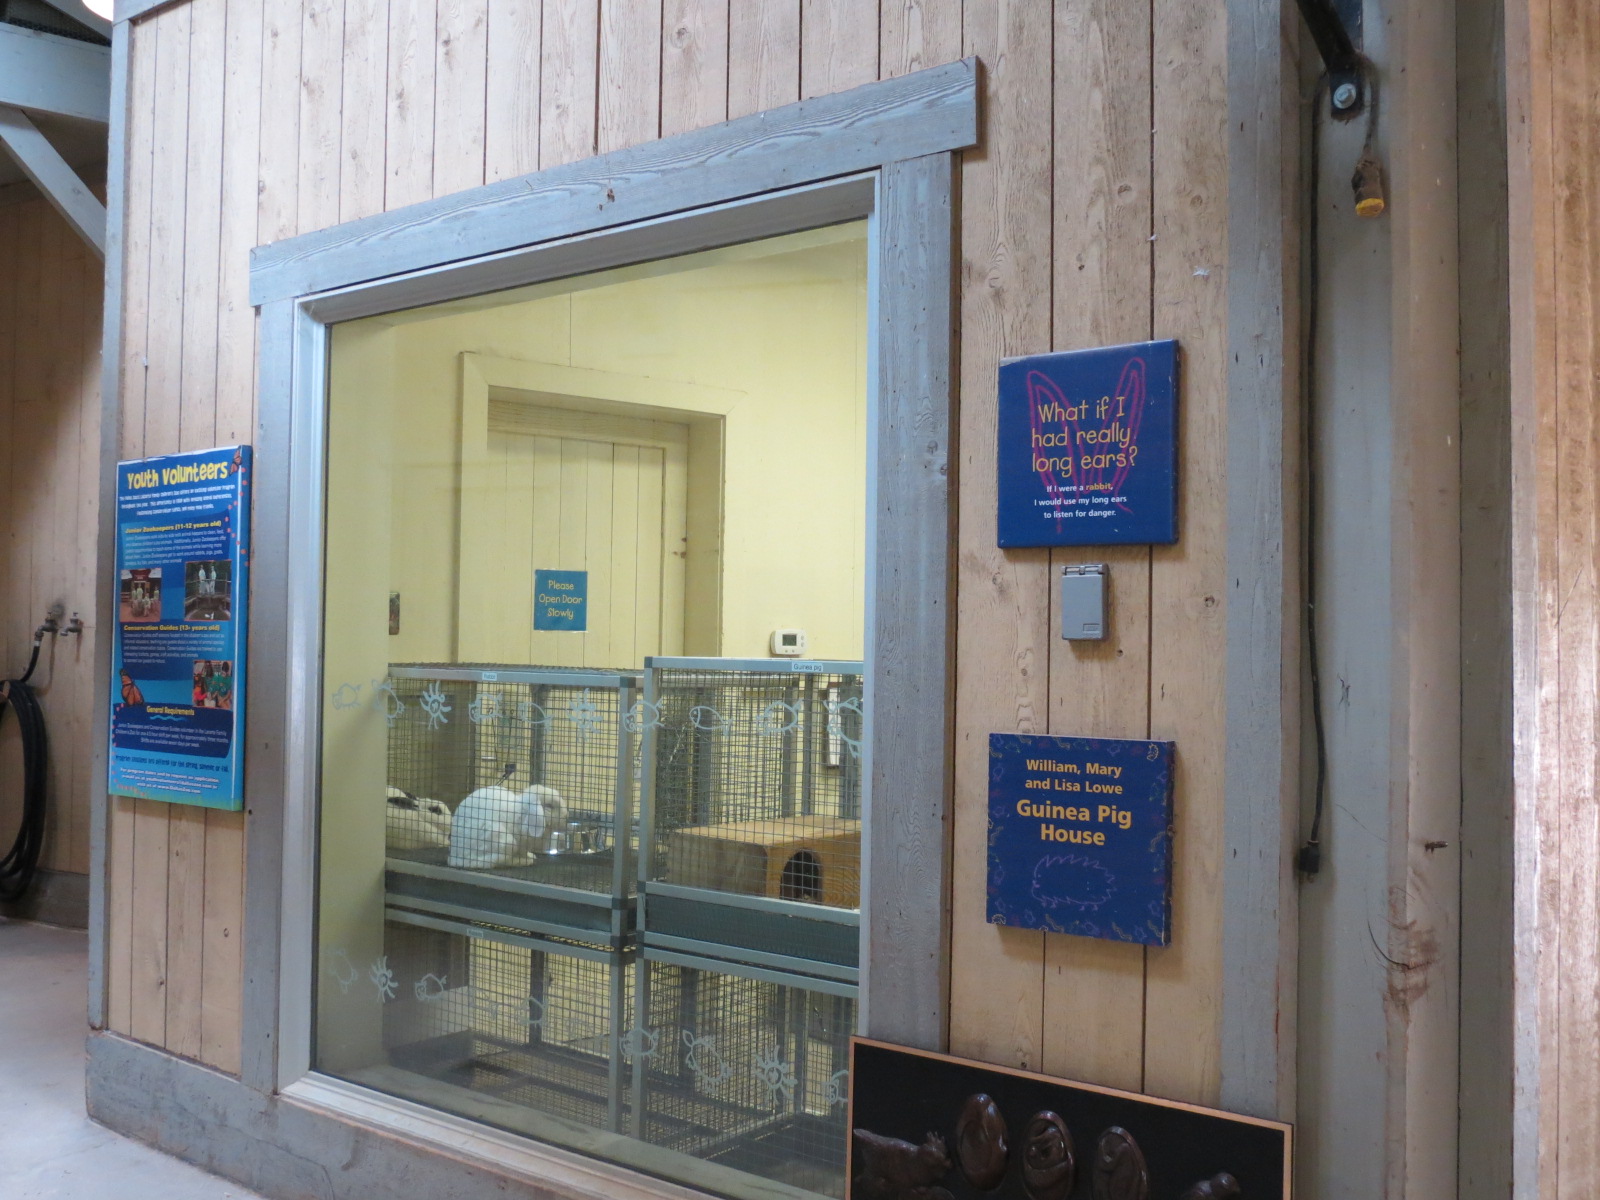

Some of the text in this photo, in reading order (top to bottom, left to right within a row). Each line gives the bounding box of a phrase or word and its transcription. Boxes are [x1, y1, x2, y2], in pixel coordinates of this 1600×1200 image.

[1038, 396, 1125, 424] What if I
[1031, 422, 1131, 449] had really
[1032, 446, 1138, 478] long ears?
[127, 461, 228, 489] Youth Volunteers
[1046, 485, 1053, 493] If
[1086, 483, 1114, 491] rabbit,
[1039, 498, 1062, 506] would
[1078, 498, 1090, 506] my
[1092, 496, 1109, 505] long
[1044, 510, 1116, 519] to listen for danger.
[548, 580, 575, 590] Please
[538, 593, 583, 606] Open Door
[547, 607, 574, 620] Slowly
[1026, 759, 1122, 779] William, Mary
[1025, 778, 1123, 795] and Lisa Lowe
[1016, 799, 1132, 830] Guinea Pig
[1041, 823, 1105, 846] House
